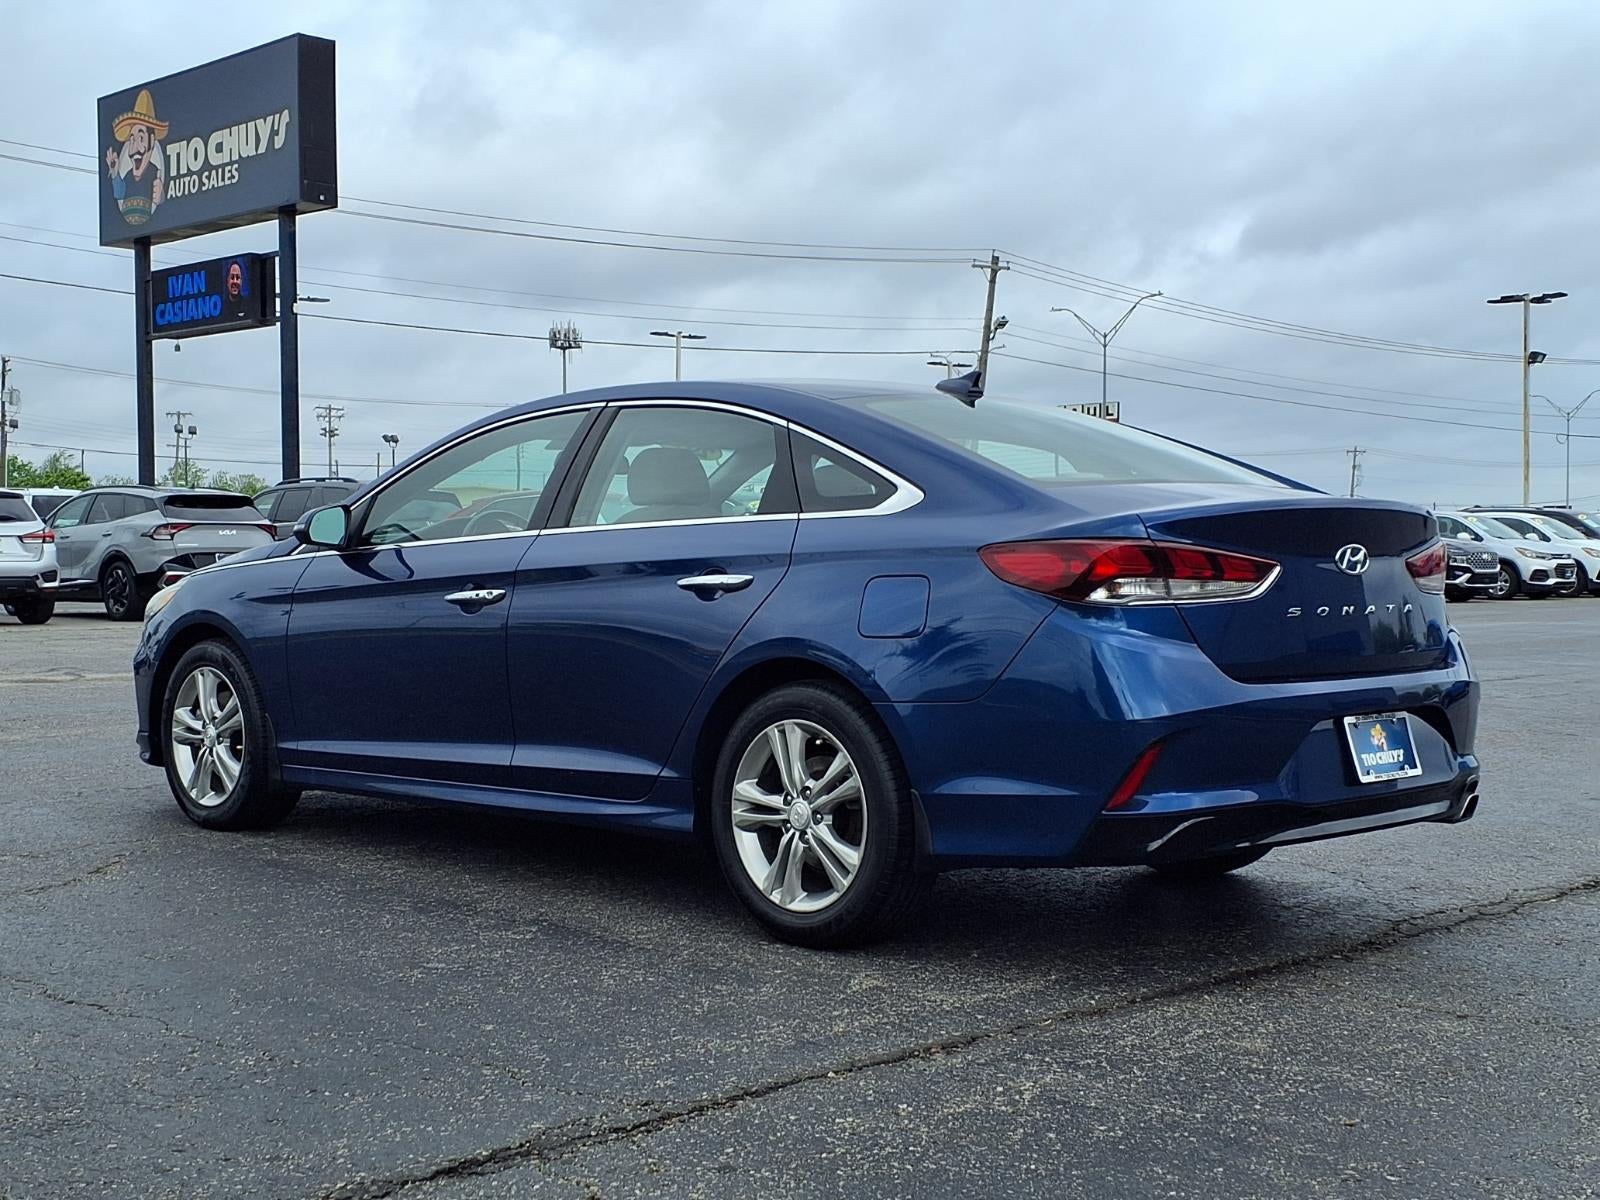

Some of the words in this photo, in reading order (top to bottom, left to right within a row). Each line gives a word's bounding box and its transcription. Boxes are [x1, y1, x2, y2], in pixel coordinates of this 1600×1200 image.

[166, 137, 205, 177] TIO
[207, 109, 290, 166] CHUY'S
[167, 175, 199, 199] AUTO
[202, 164, 239, 191] SALES
[167, 271, 206, 298] IVAN
[155, 294, 223, 326] CASIANO
[1286, 603, 1413, 617] SONATA
[1361, 752, 1377, 767] TIO
[1376, 749, 1404, 765] CHUY'S
